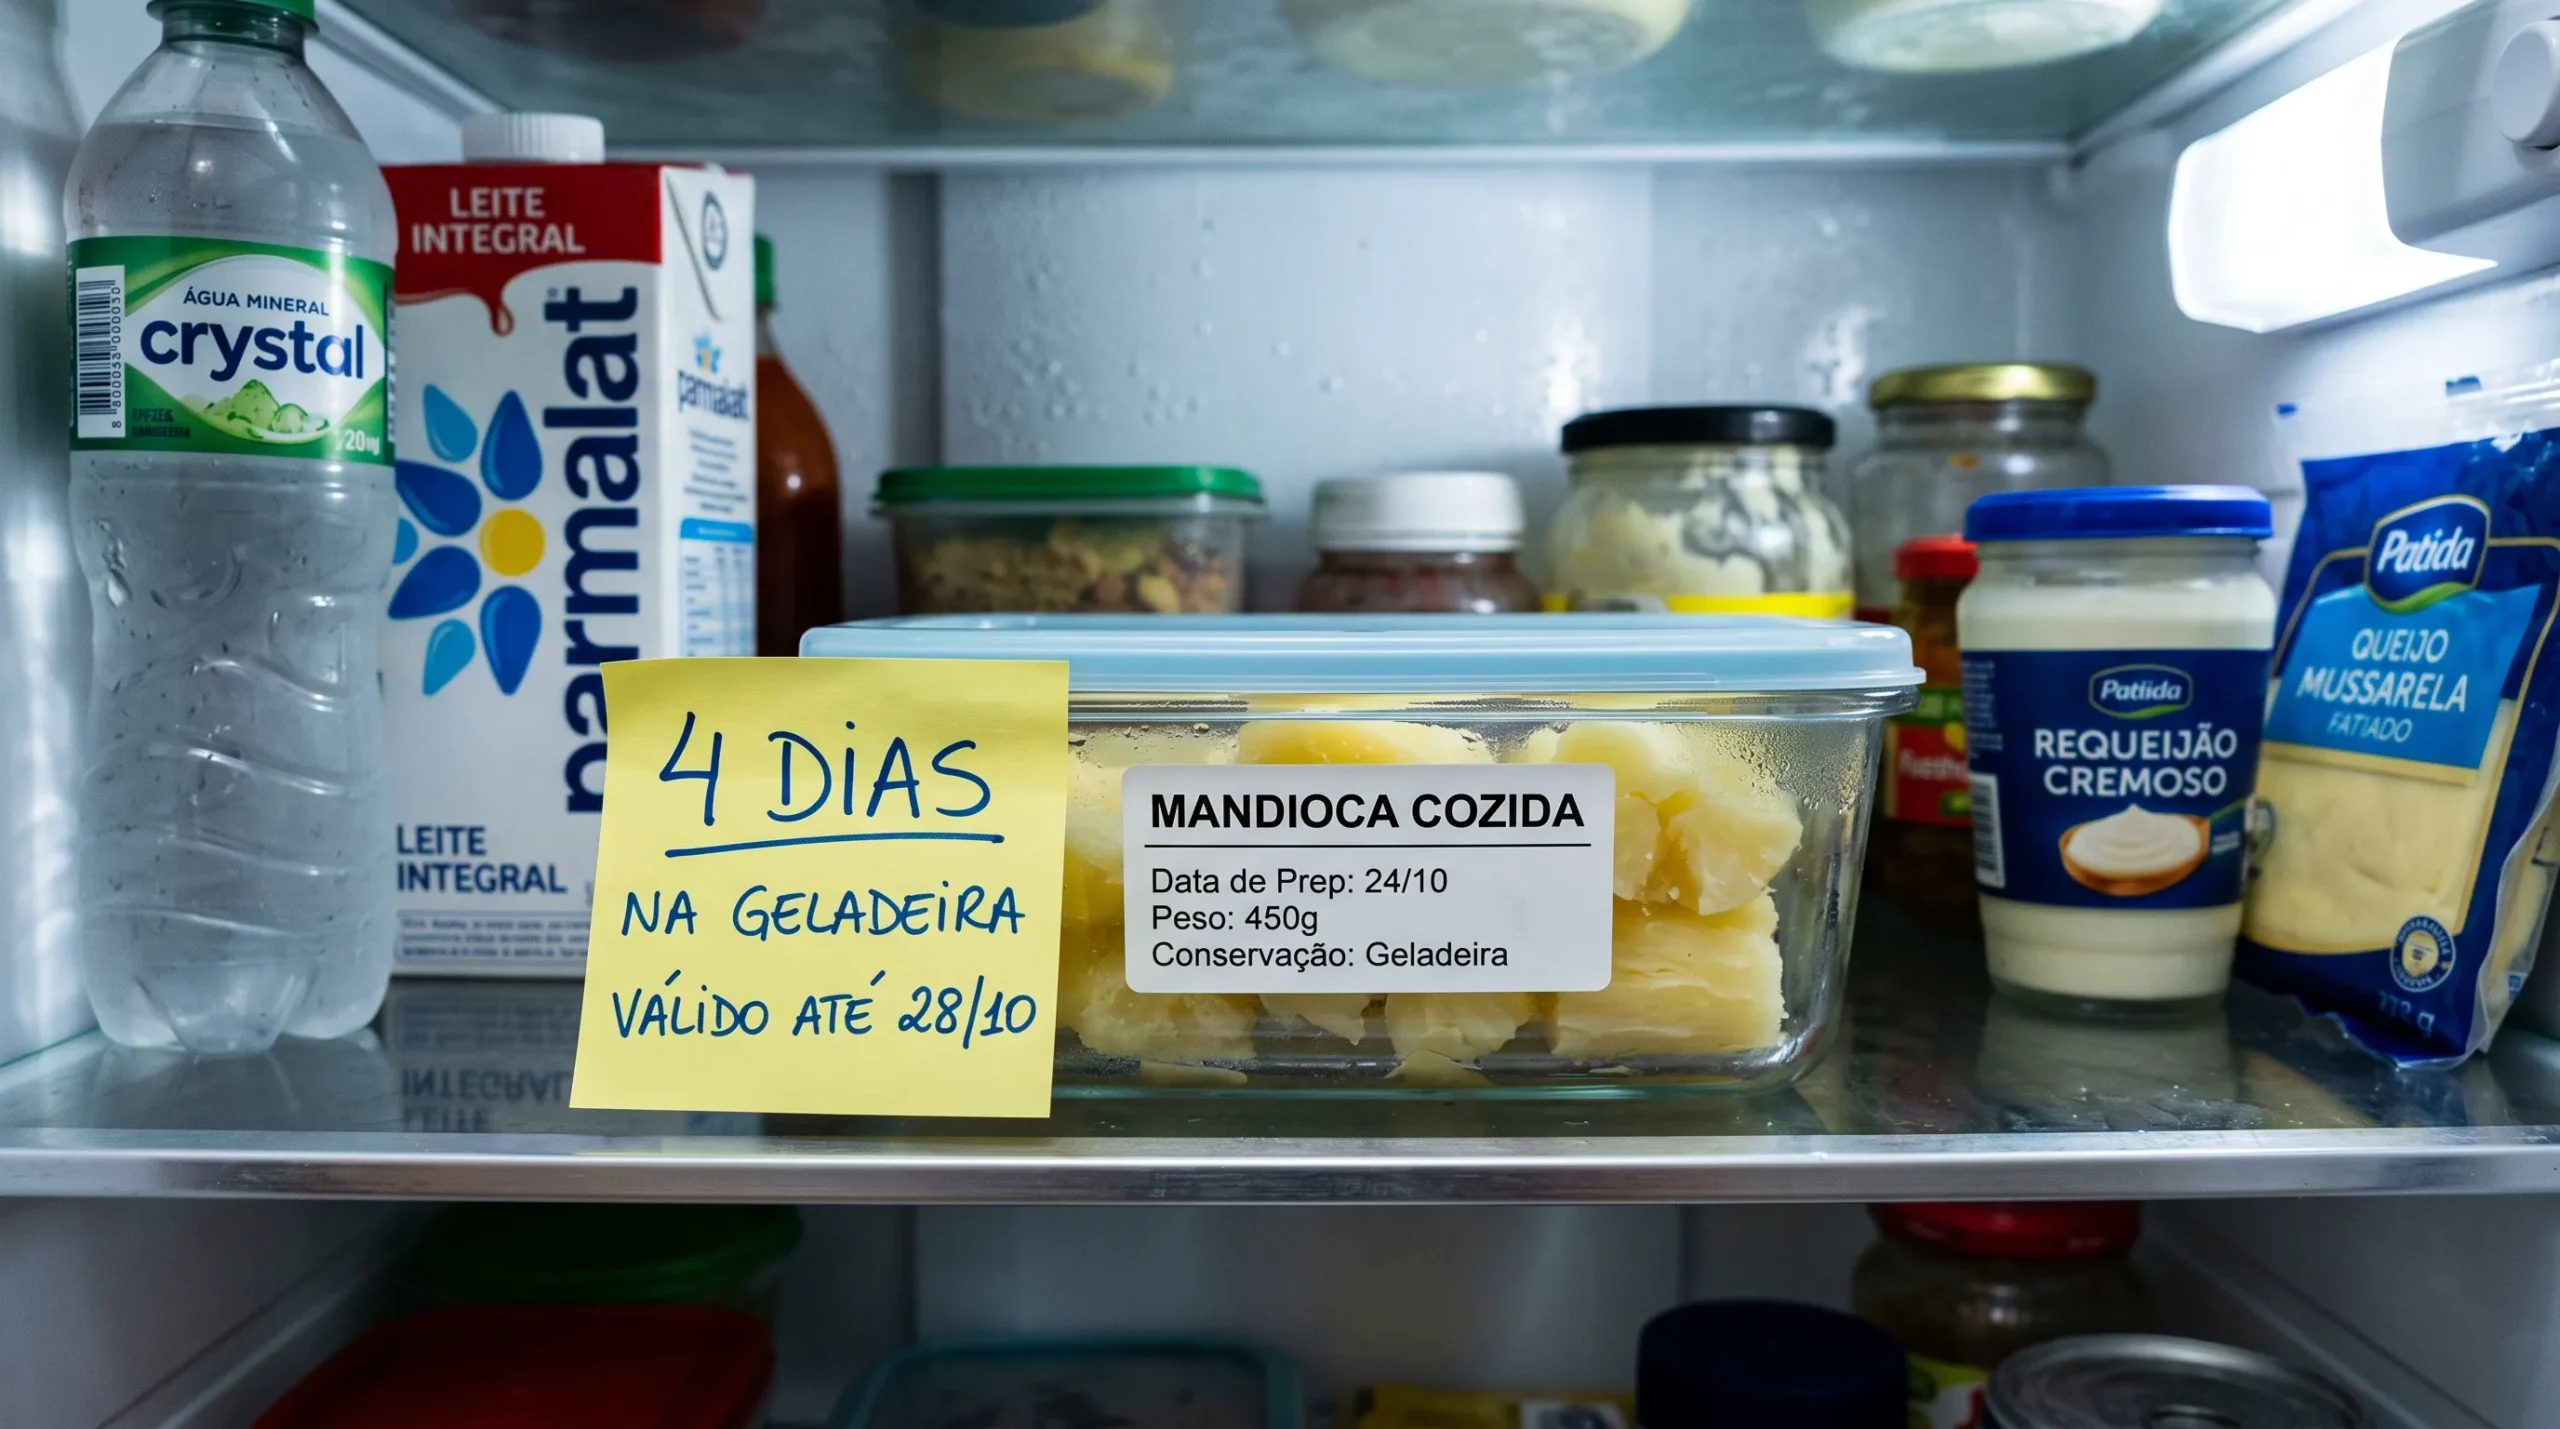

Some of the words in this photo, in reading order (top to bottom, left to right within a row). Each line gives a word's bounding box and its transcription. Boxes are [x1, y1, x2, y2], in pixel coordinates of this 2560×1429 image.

[450, 187, 546, 218] LEITE
[412, 223, 586, 254] INTEGRAL
[183, 286, 240, 308] ÁGUA
[247, 294, 330, 316] MINERAL
[140, 320, 363, 382] crystal
[2352, 628, 2449, 663] QUEIJO
[2295, 666, 2469, 712] MUSSARELA
[2034, 722, 2238, 760] REQUEIJÃO
[2327, 711, 2413, 743] FATIADO
[659, 711, 722, 826] 4
[2044, 765, 2228, 797] CREMOSO
[1151, 793, 1399, 829] MANDIOCA
[1411, 793, 1585, 828] COZIDA
[397, 824, 486, 856] LEITE
[397, 862, 568, 894] INTEGRAL
[1151, 868, 1220, 894] Data
[1230, 868, 1266, 894] de
[1277, 868, 1354, 899] Prep:
[1365, 868, 1448, 894] 24/10
[621, 891, 698, 936] NA
[1152, 906, 1234, 931] Peso:
[1245, 906, 1318, 936] 450g
[1152, 941, 1354, 972] Conservação:
[1366, 942, 1508, 967] Geladeira
[792, 969, 886, 1036] ATÉ
[899, 975, 1037, 1050] 28/10
